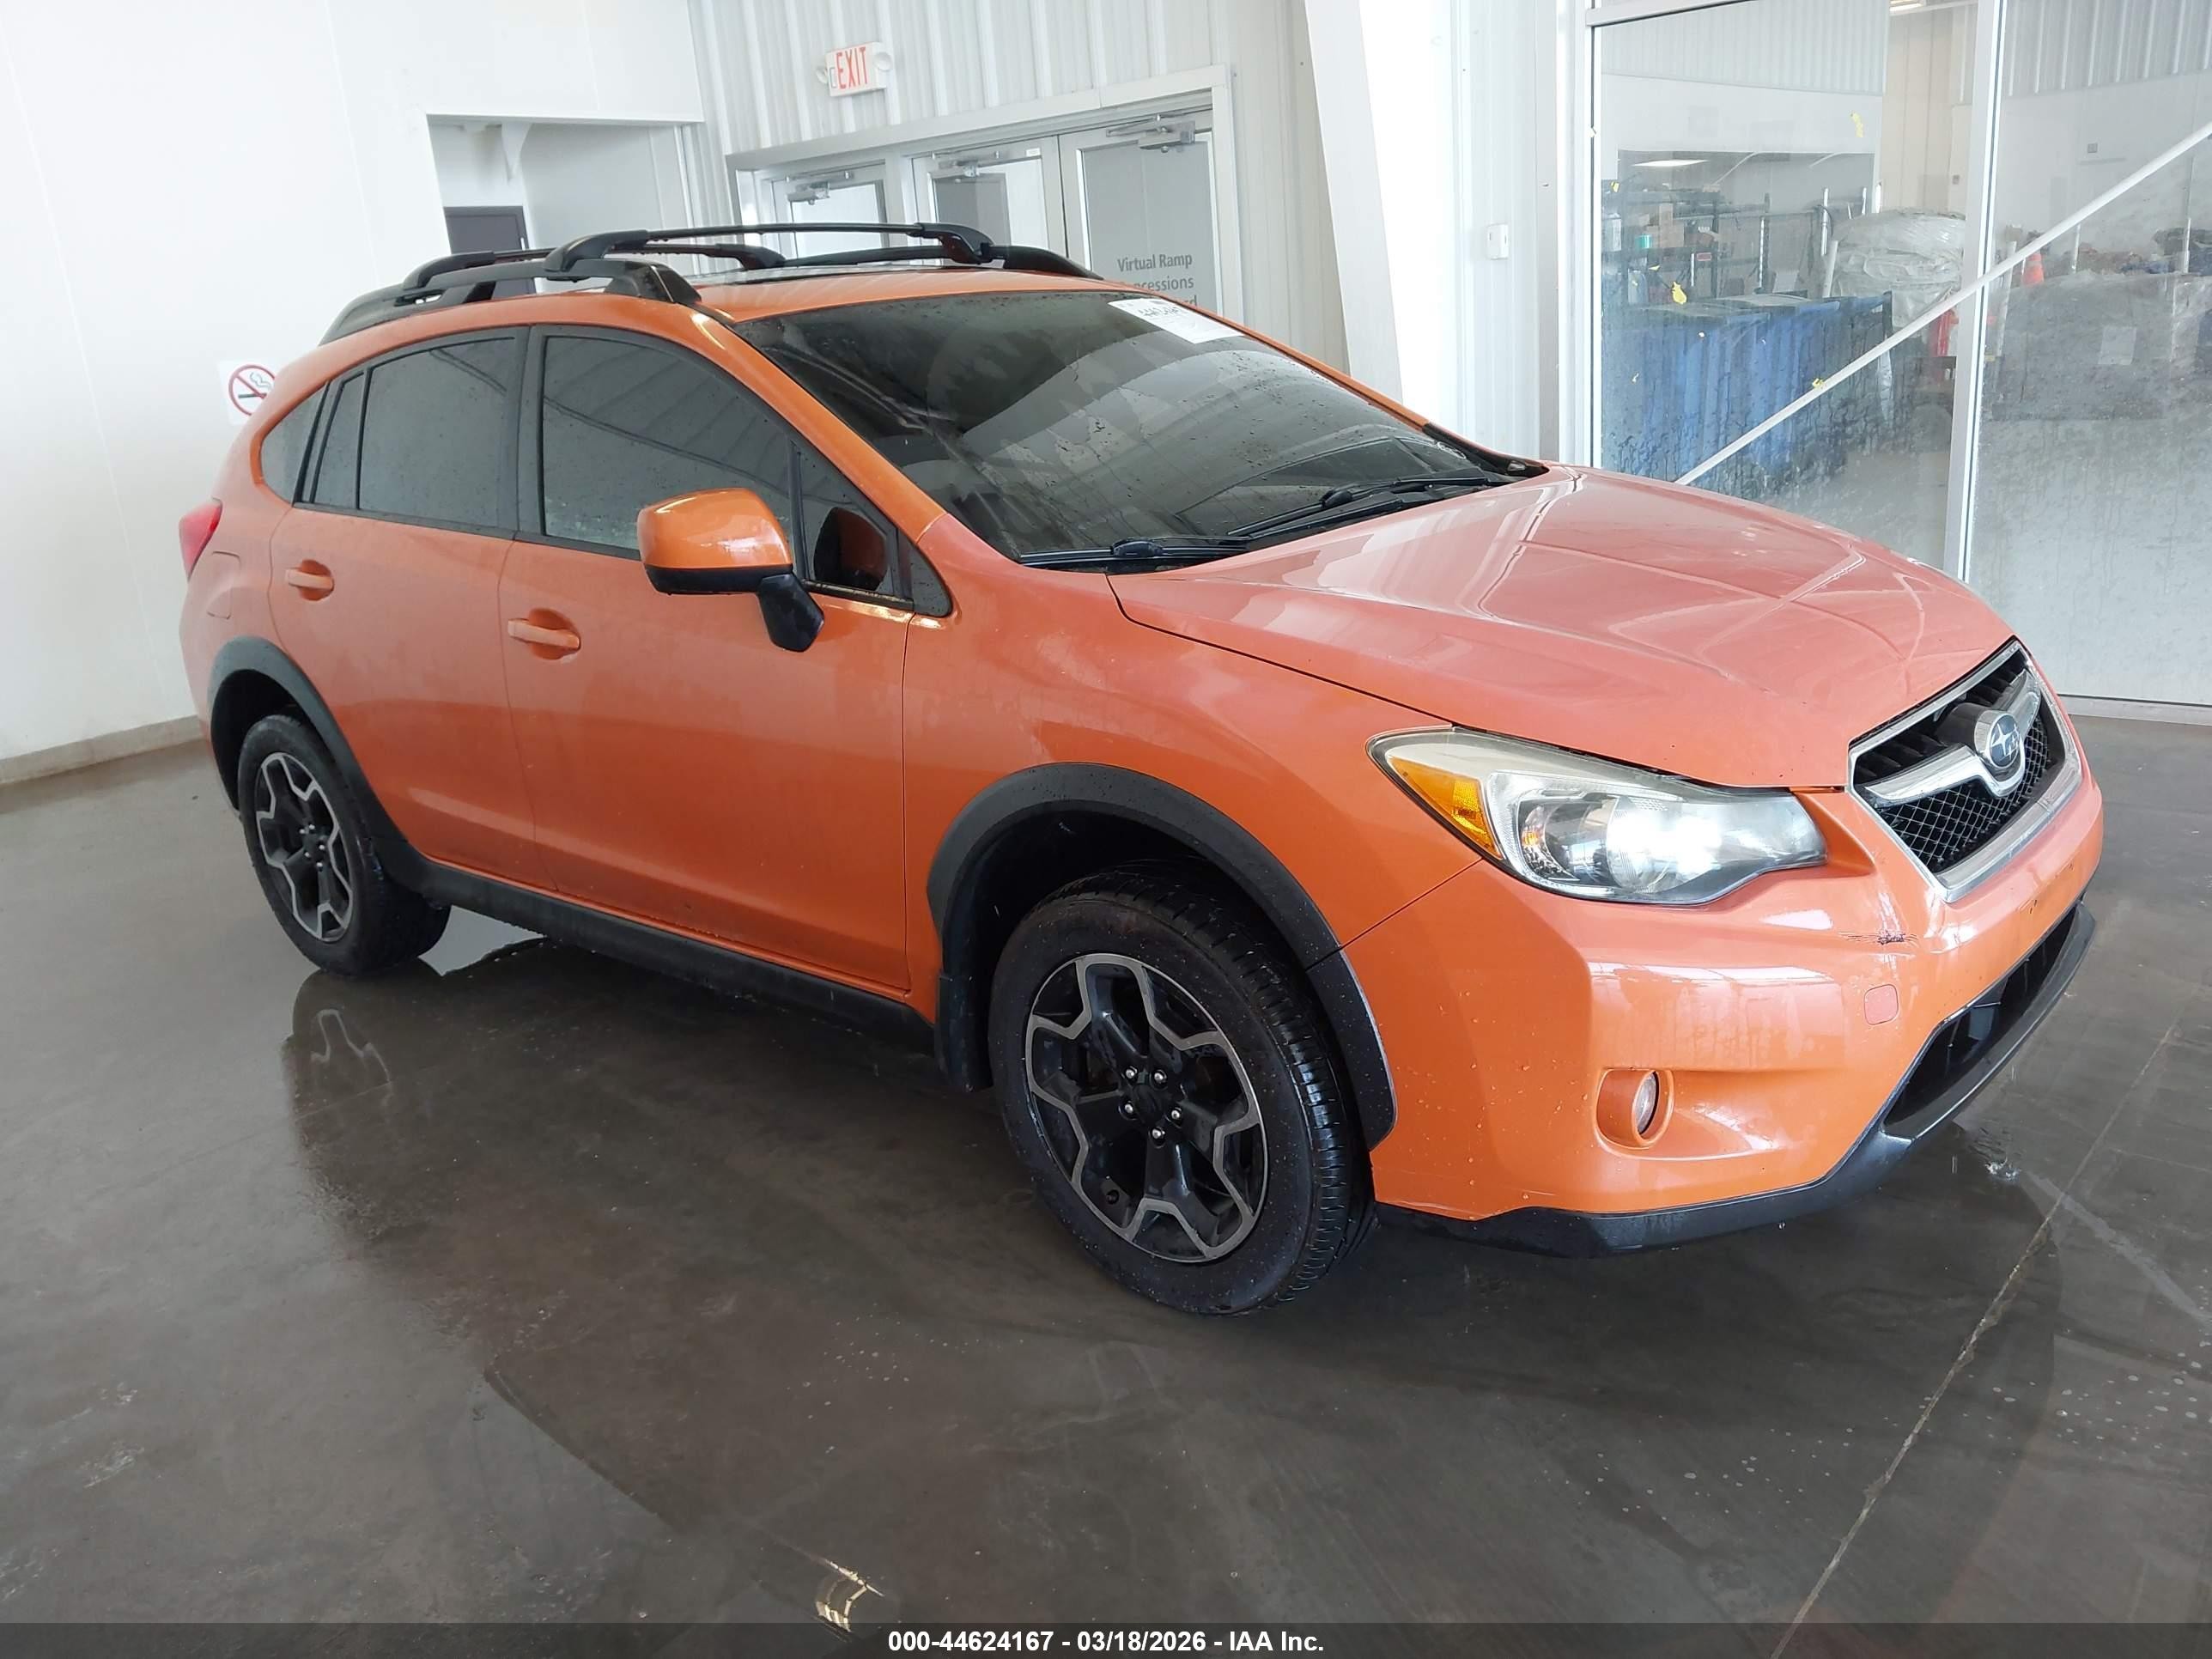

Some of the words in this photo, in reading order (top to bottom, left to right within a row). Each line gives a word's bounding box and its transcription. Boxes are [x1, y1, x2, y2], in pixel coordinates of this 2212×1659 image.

[836, 46, 867, 89] EXIT
[1117, 254, 1156, 272] Virtual
[1159, 254, 1193, 270] Ramp
[1120, 276, 1194, 292] cessions
